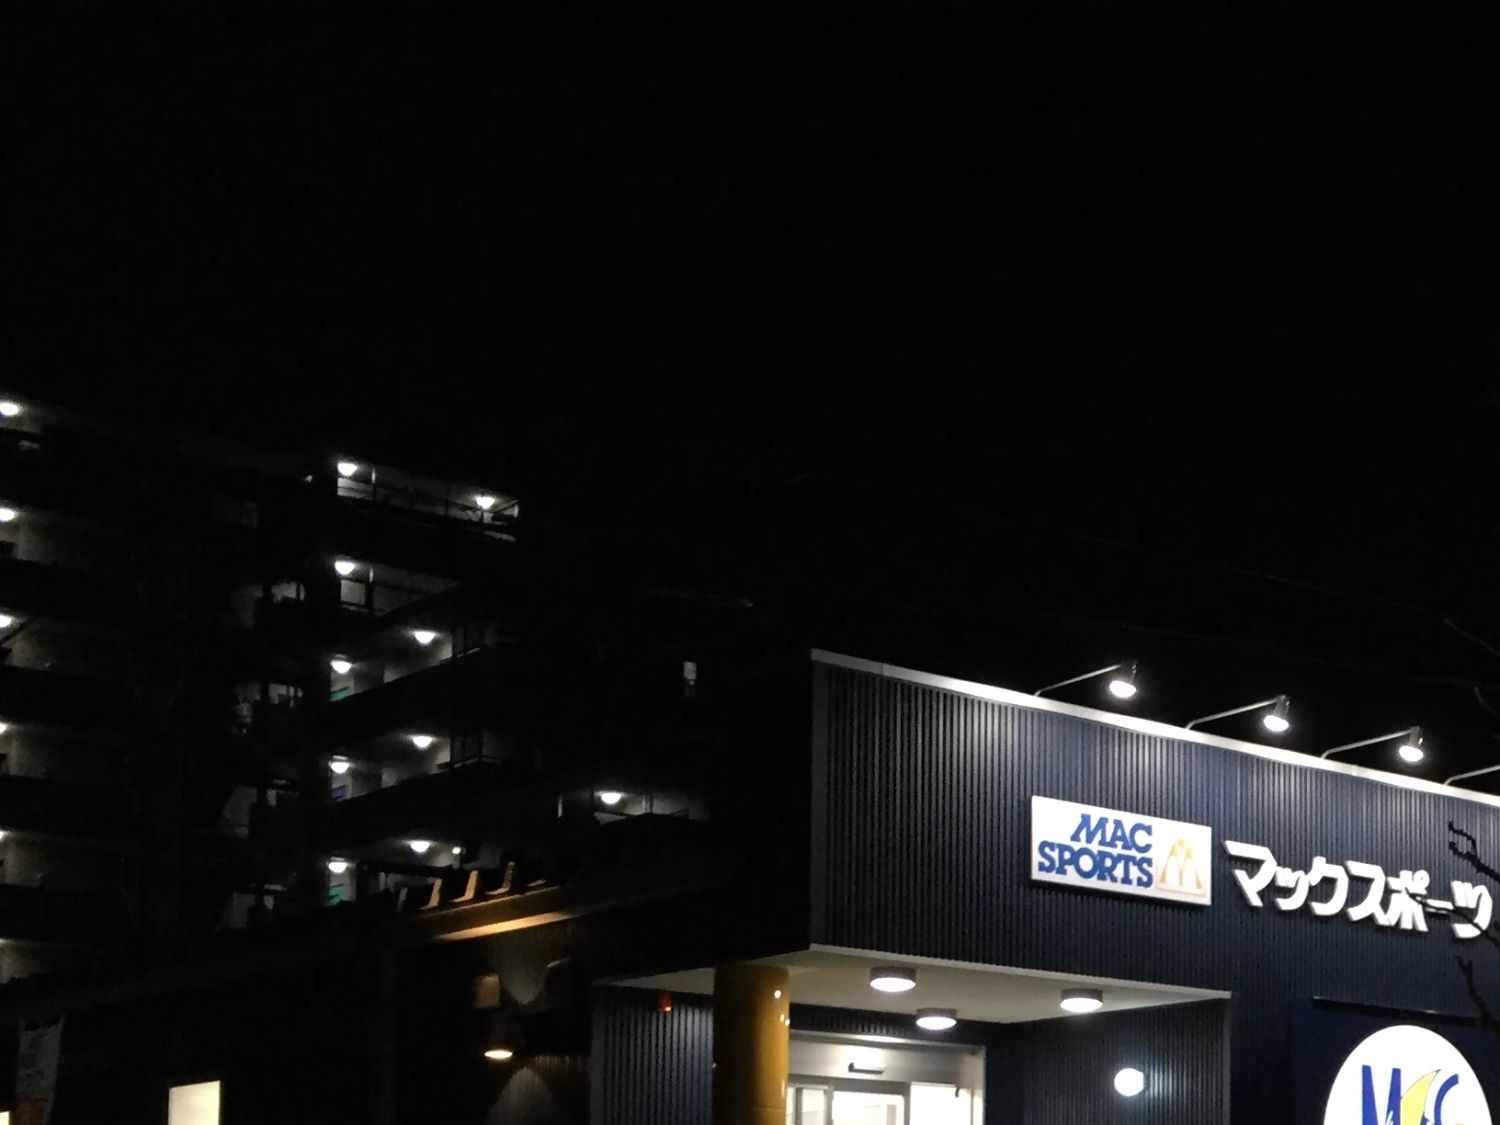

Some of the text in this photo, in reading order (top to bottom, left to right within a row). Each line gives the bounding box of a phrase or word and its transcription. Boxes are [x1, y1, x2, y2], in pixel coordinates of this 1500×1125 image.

[1070, 813, 1153, 854] MAC
[1037, 840, 1154, 889] SPORTS
[1223, 839, 1494, 939] マックスポーツ
